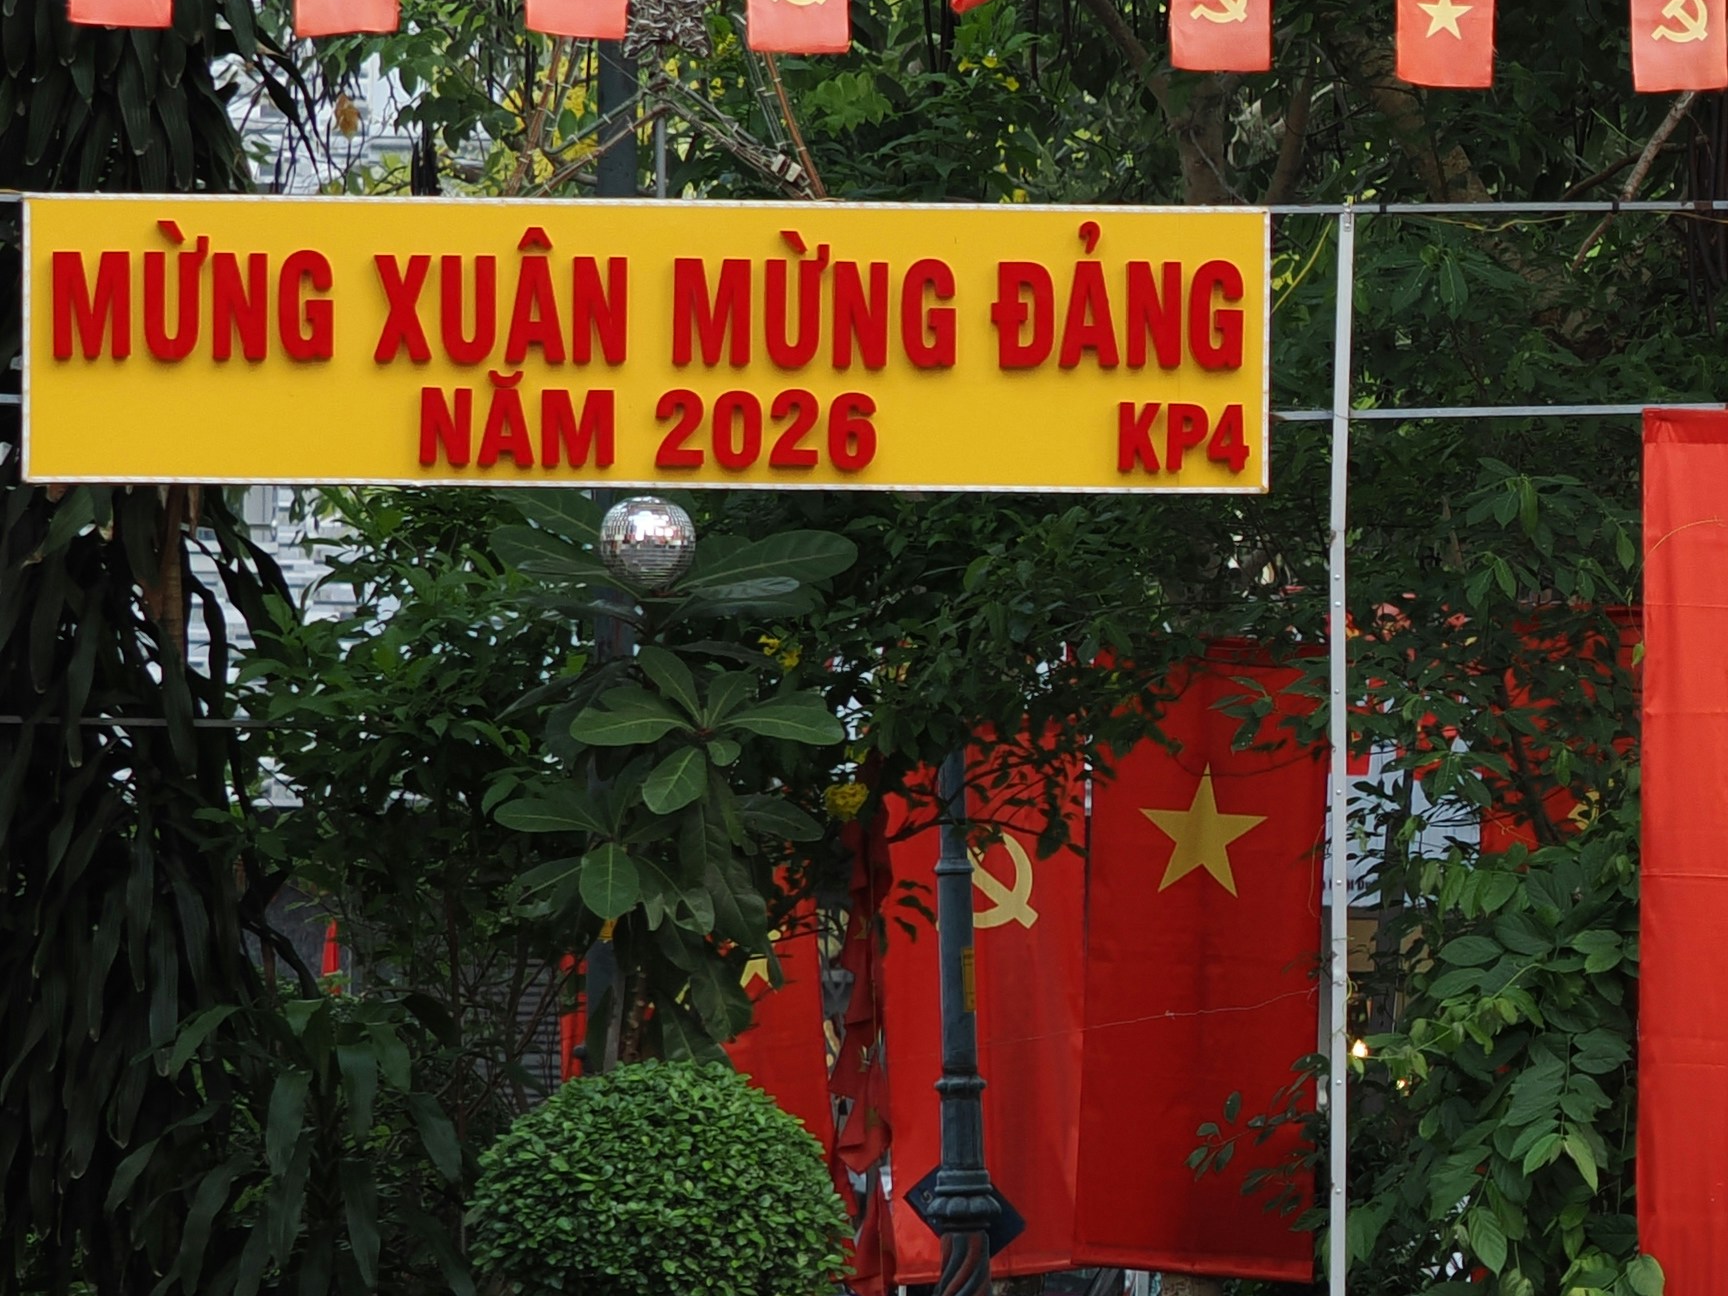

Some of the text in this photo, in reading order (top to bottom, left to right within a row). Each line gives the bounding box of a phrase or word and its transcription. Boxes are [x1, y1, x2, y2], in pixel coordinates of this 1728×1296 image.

[52, 220, 1244, 370] MỪNG XUÂN MỪNG ĐẢNG
[419, 370, 877, 472] NĂM 2026
[1118, 402, 1250, 473] KP4
